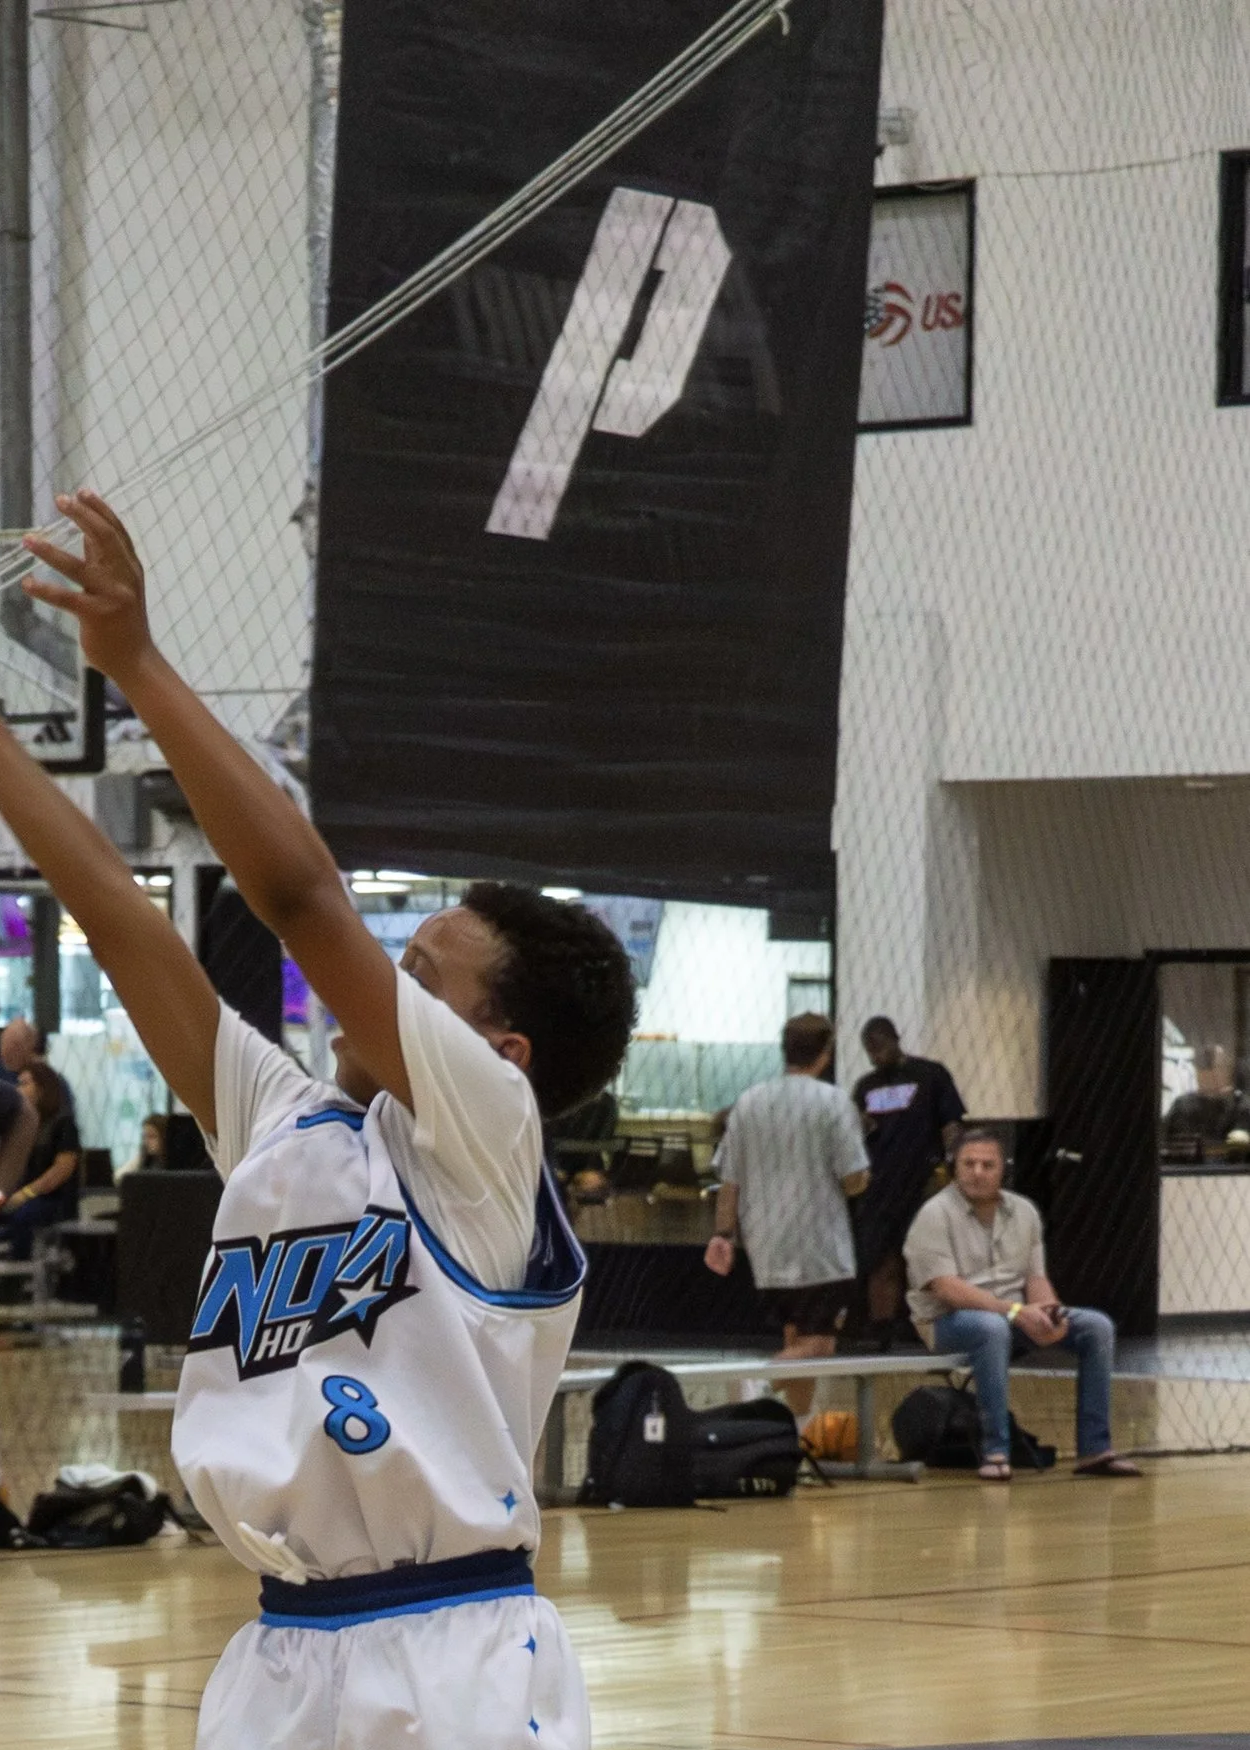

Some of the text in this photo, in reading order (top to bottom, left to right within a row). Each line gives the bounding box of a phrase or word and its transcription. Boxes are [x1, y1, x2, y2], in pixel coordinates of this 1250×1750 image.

[920, 290, 965, 332] US
[485, 187, 733, 541] P
[253, 1318, 314, 1362] HO
[321, 1374, 392, 1455] 8
